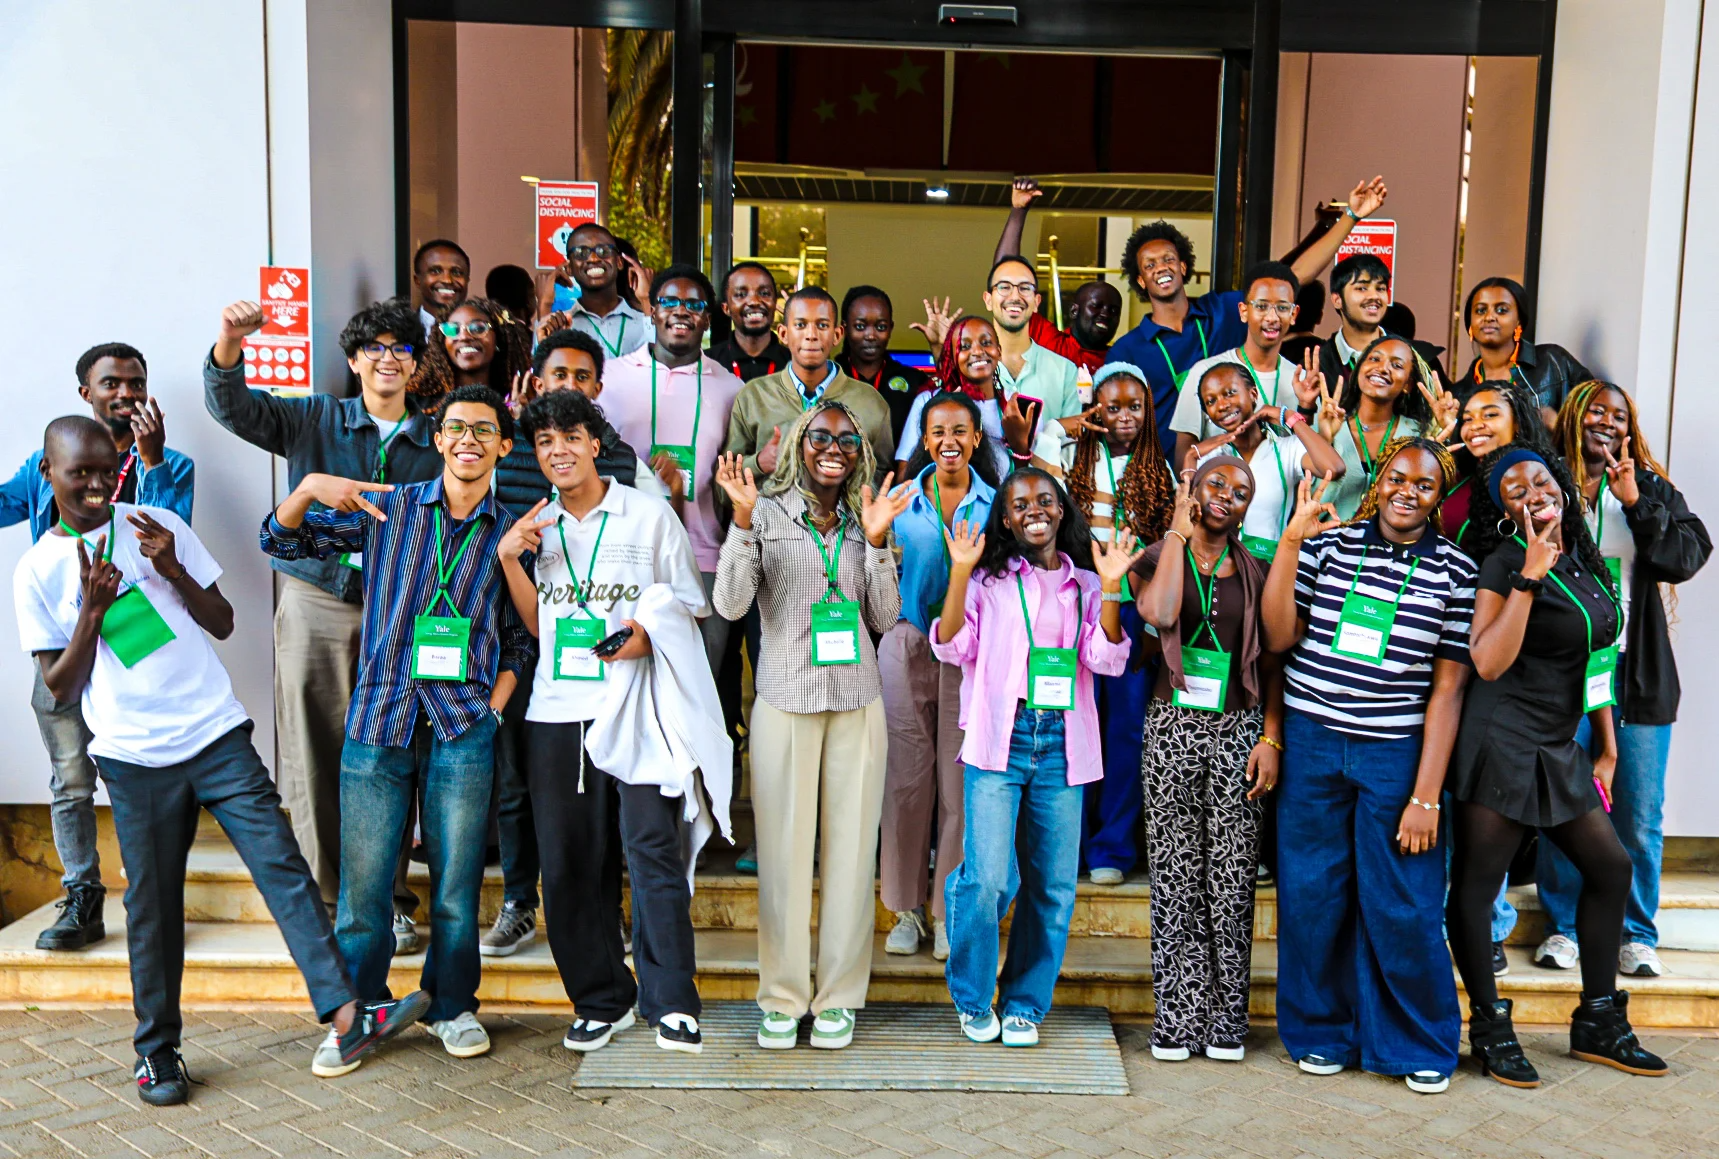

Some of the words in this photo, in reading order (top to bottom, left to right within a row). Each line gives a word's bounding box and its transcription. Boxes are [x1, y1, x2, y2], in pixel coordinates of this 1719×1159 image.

[539, 196, 572, 207] SOCIAL
[539, 207, 595, 219] DISTANCING
[1343, 234, 1371, 245] OCIAL
[1338, 245, 1393, 255] DISTANCING
[271, 306, 300, 317] HERE
[537, 578, 642, 613] Heritage
[828, 610, 843, 618] Yale
[1363, 604, 1378, 615] Yale
[434, 624, 450, 633] Yale
[572, 625, 587, 634] Yale
[1046, 655, 1060, 663] Yale
